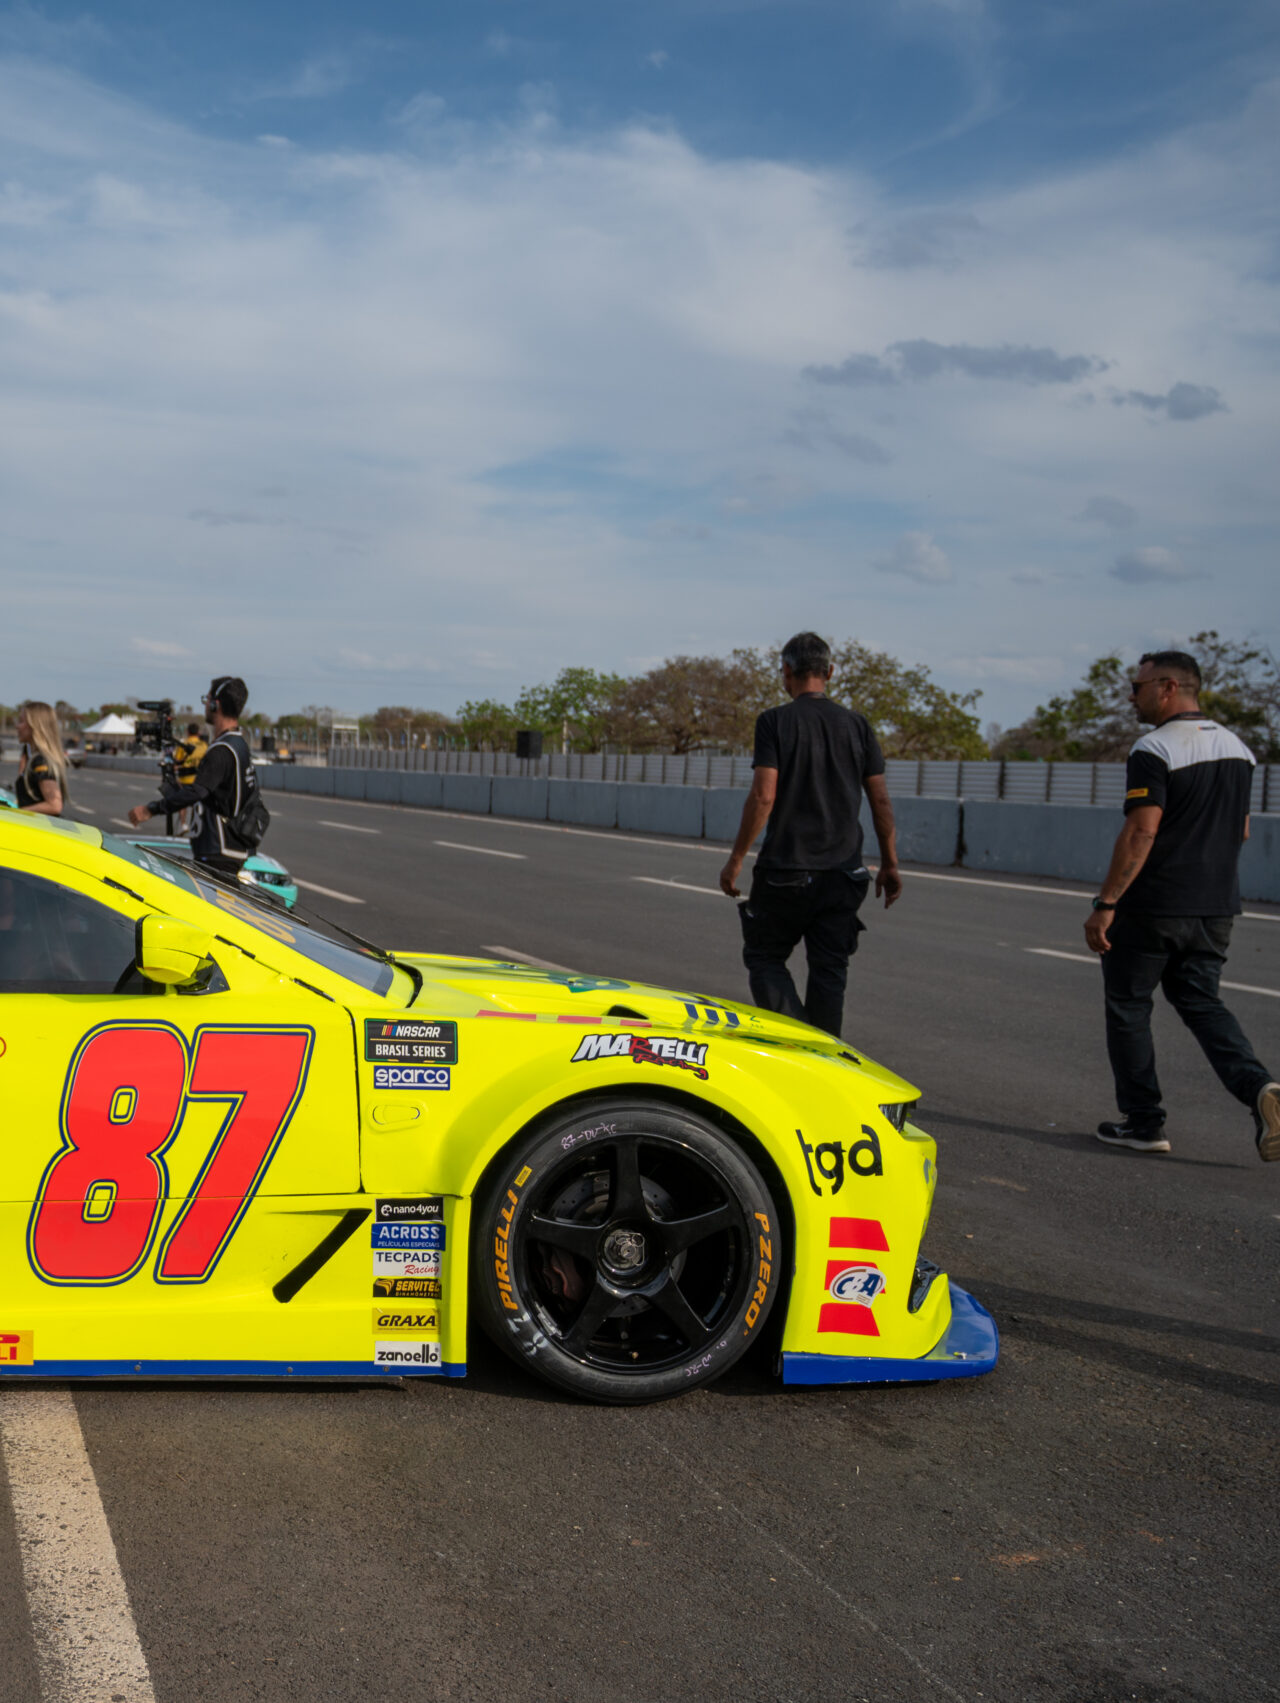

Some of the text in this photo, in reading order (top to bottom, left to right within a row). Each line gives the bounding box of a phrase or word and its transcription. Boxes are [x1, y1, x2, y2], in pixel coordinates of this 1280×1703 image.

[395, 1025, 441, 1038] NASCAR
[375, 1043, 447, 1058] BRASIL SERIES
[570, 1033, 709, 1067] MARTELLI
[375, 1068, 449, 1088] sparco
[27, 1019, 316, 1287] 87
[379, 1226, 440, 1240] ACROSS
[375, 1251, 440, 1263] TECPADS
[494, 1189, 519, 1311] PIRELLI
[404, 1264, 440, 1276] Racing
[395, 1281, 440, 1292] SERVITEC
[377, 1315, 436, 1327] GRAXA
[377, 1343, 438, 1364] zanoello
